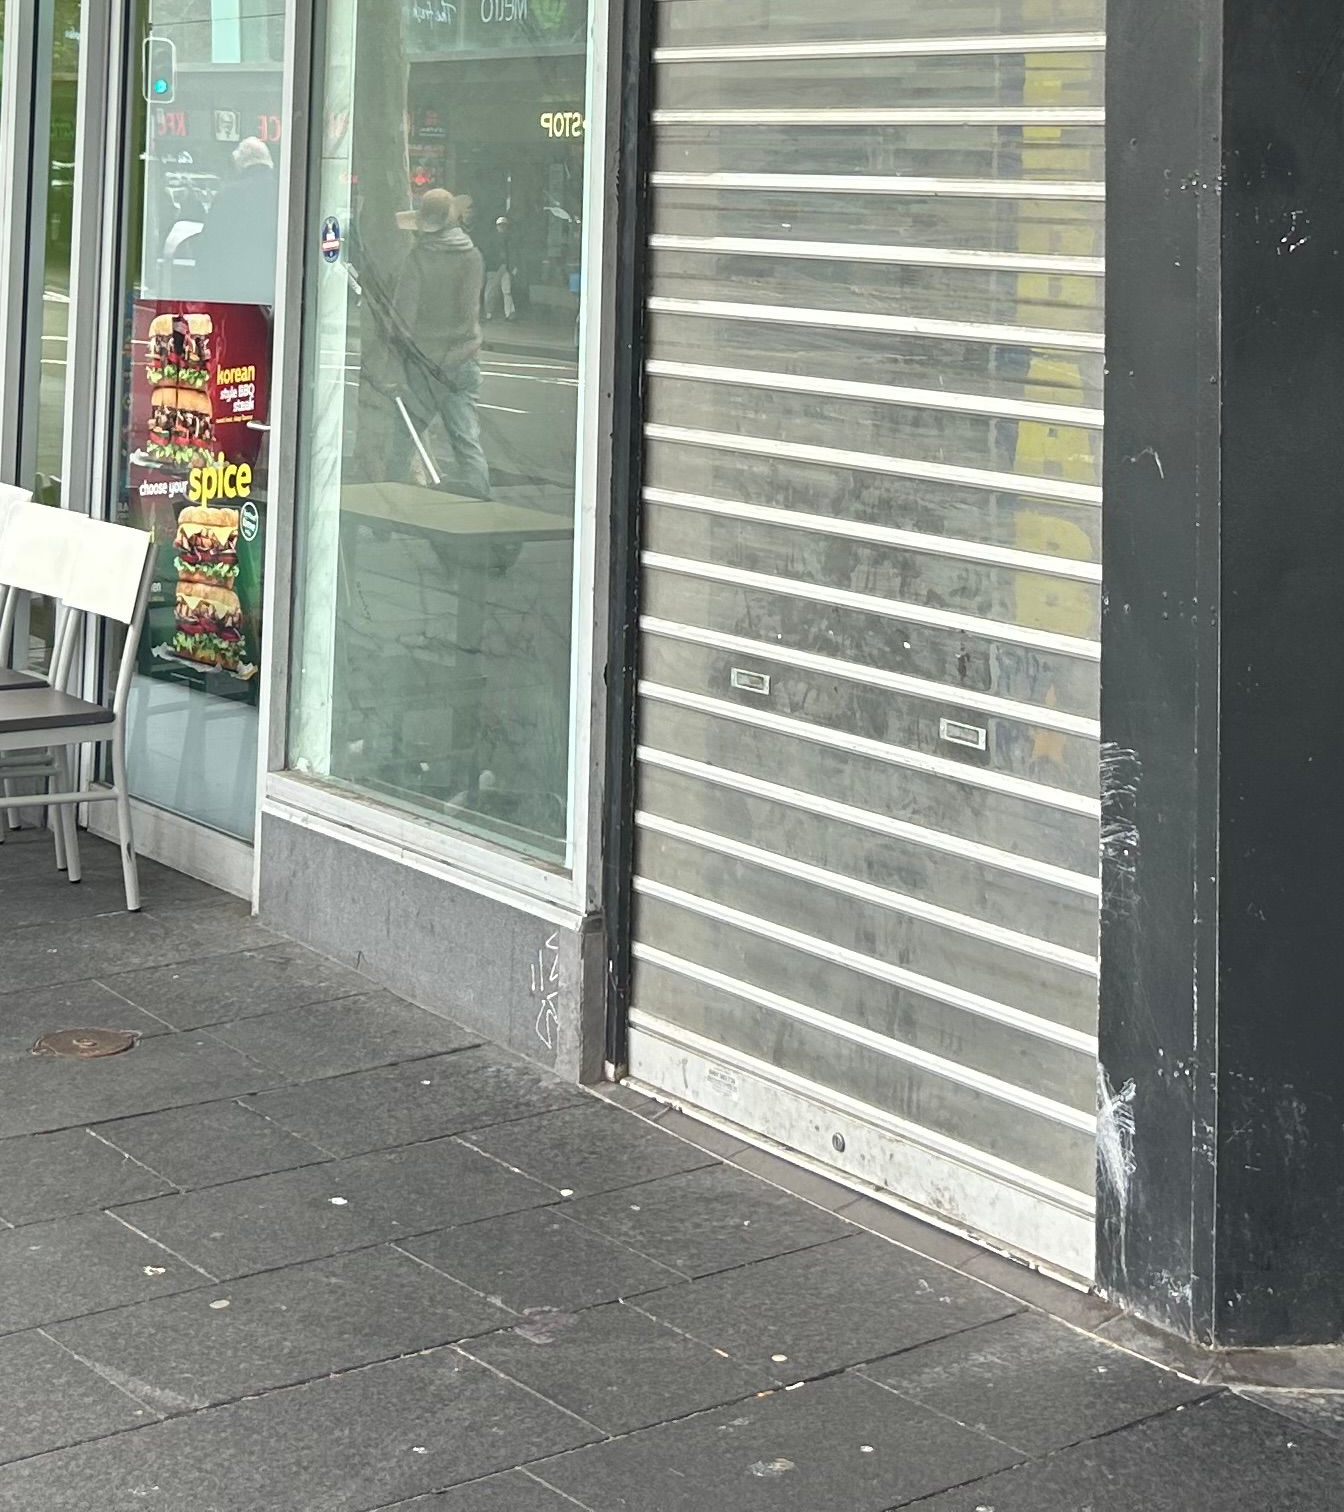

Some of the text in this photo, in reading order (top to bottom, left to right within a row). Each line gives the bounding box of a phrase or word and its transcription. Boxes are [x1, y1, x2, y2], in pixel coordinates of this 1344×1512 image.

[217, 364, 256, 386] korean
[219, 382, 256, 403] style BBQ
[232, 397, 255, 413] steak
[139, 452, 253, 512] choose your spice
